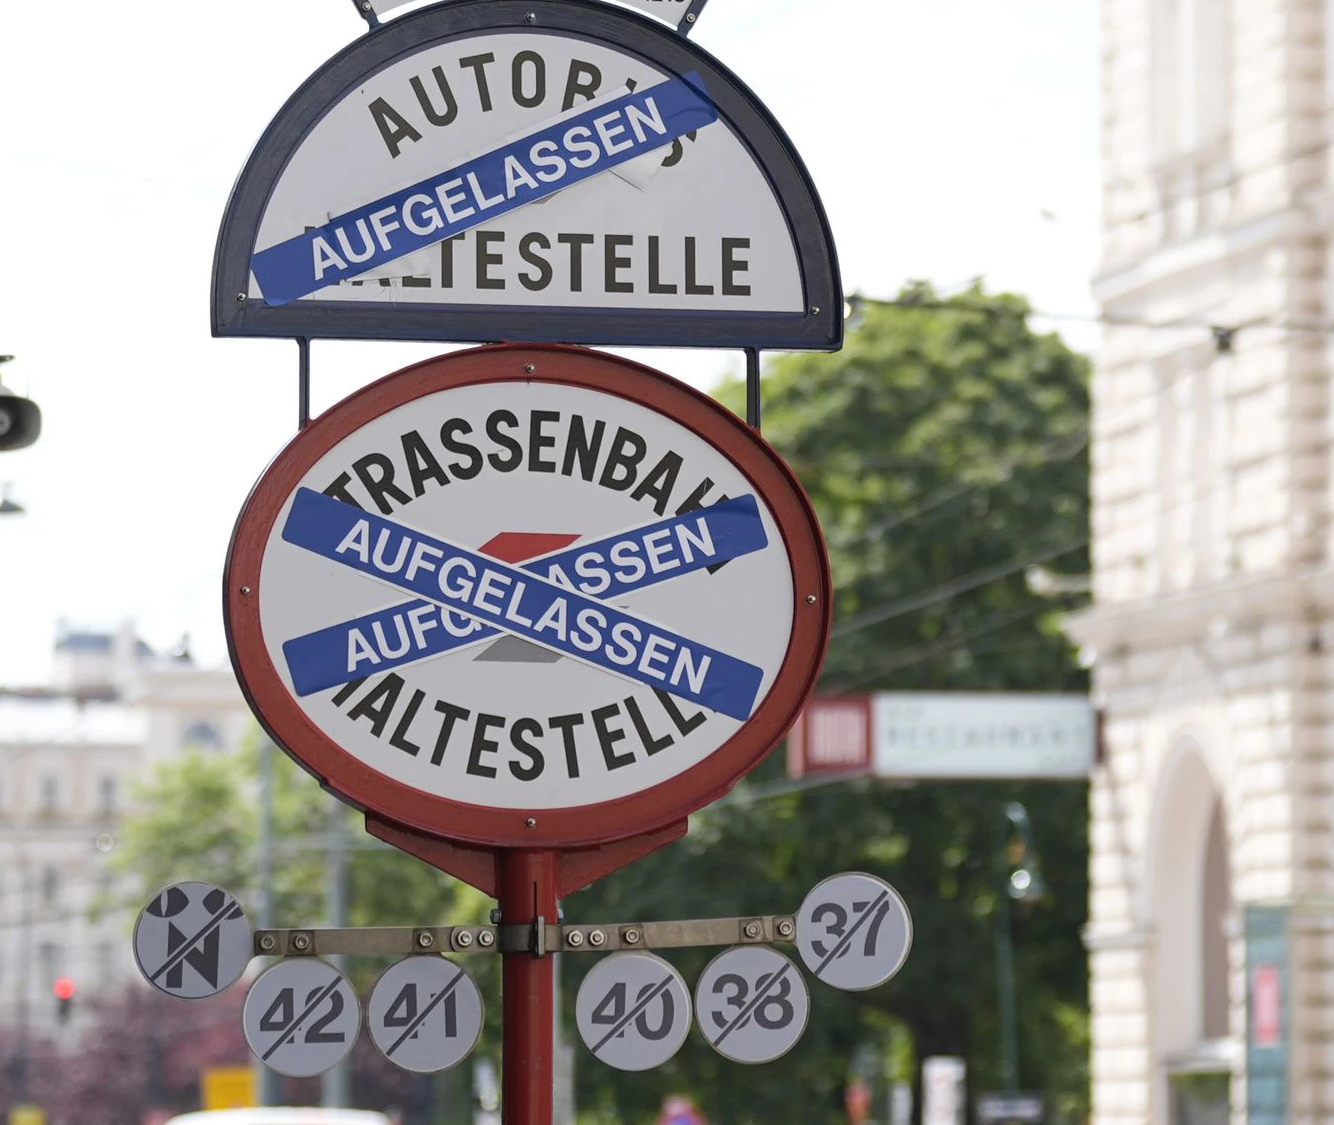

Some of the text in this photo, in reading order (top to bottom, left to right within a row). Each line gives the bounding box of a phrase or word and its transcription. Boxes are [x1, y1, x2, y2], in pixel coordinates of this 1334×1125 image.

[312, 96, 667, 281] AUFGELASSEN
[335, 518, 712, 695] AUFGELASSEN
[331, 672, 715, 782] ALTESTELL
[165, 920, 220, 990] N
[810, 900, 890, 960] 37
[259, 985, 346, 1045] 42
[383, 982, 457, 1040] 41
[591, 981, 675, 1041] 40
[711, 971, 794, 1031] 38
